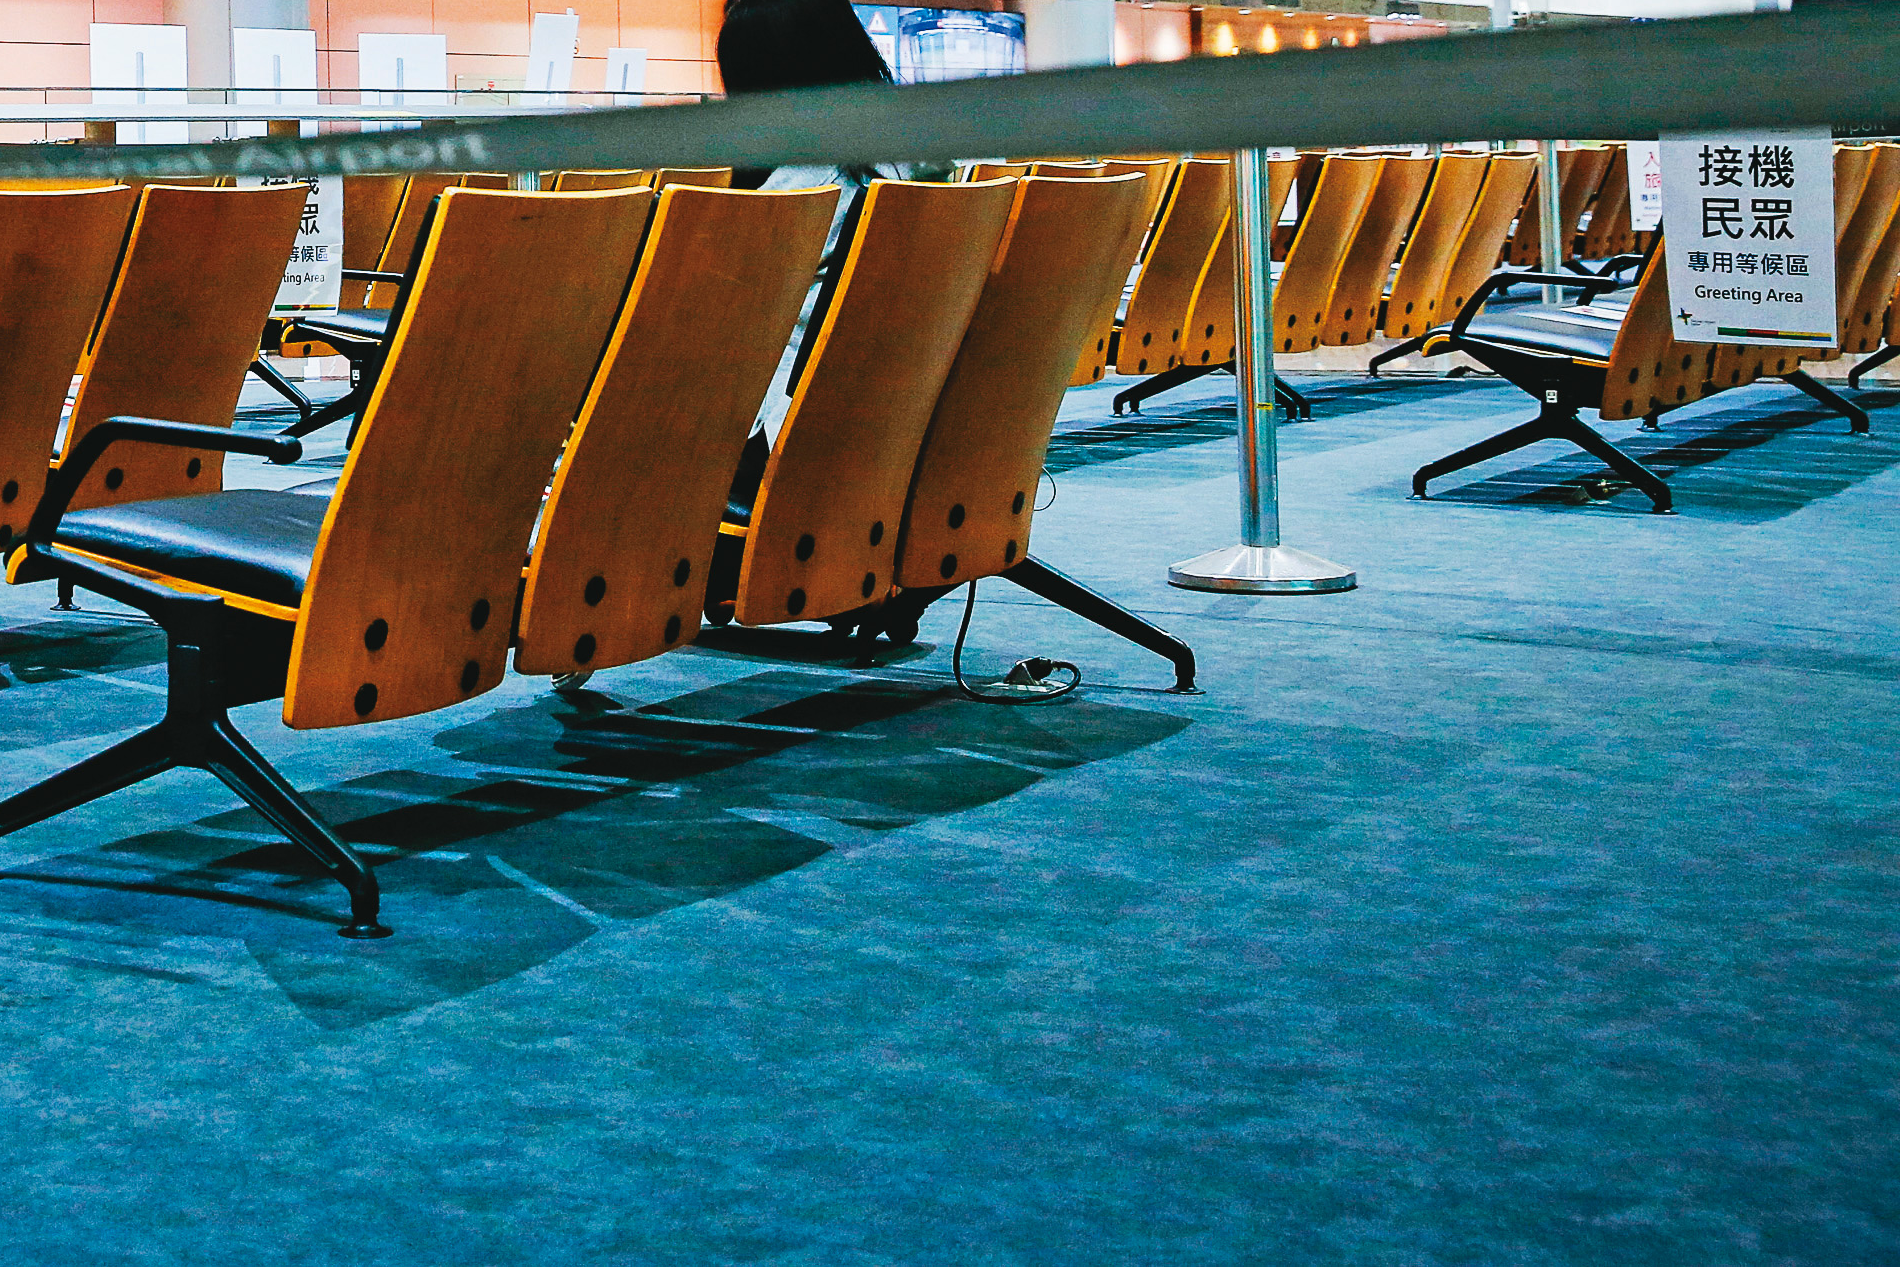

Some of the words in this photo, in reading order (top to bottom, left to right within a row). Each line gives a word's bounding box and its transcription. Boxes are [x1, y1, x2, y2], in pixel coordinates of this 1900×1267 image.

[1698, 145, 1794, 188] 接機
[1702, 198, 1794, 240] 民眾
[289, 246, 328, 262] 等候區
[1688, 251, 1809, 276] 專用等候區
[304, 273, 324, 282] Area
[1695, 285, 1761, 304] Greeting
[1766, 288, 1803, 303] Area
